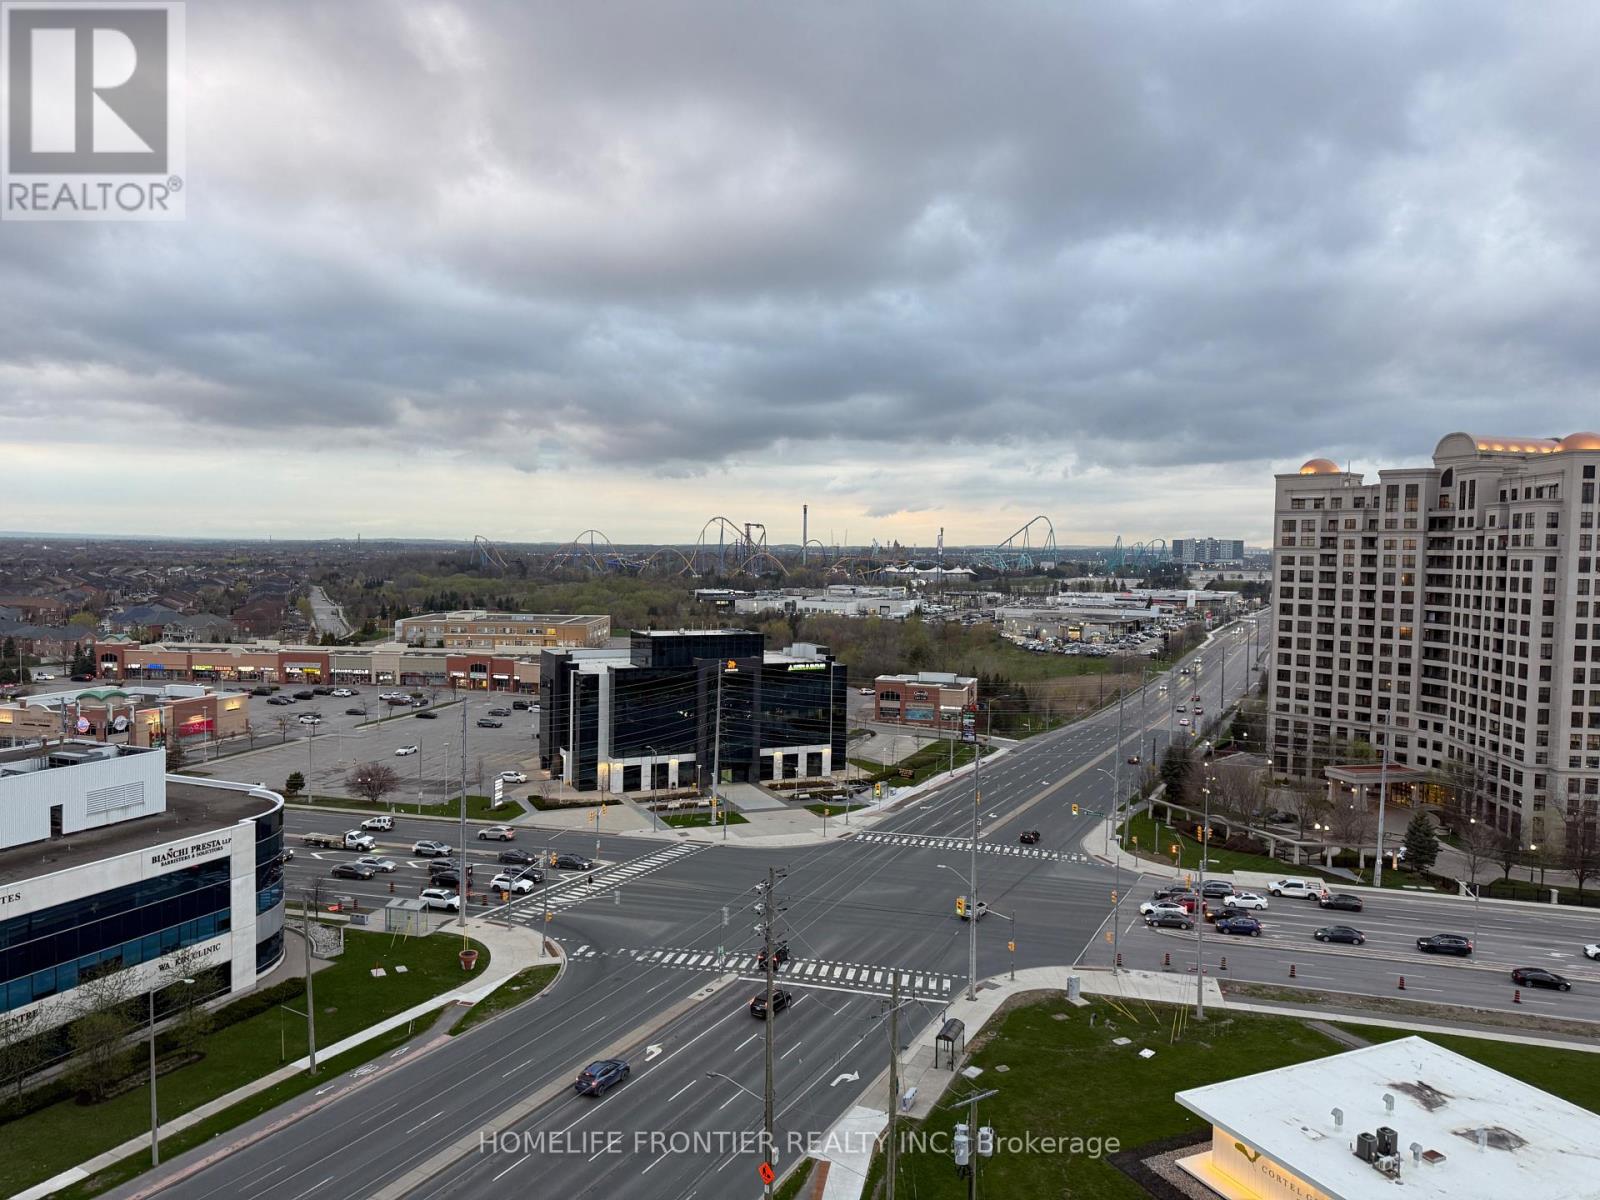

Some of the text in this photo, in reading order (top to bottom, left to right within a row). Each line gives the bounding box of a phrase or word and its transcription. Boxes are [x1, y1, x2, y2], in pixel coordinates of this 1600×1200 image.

[151, 847, 189, 864] BIANCHI
[191, 839, 221, 853] PRESTA
[161, 855, 191, 867] BARRISTERS
[196, 846, 224, 857] SOLICITORS
[193, 943, 221, 958] CLINIC
[1261, 1165, 1302, 1196] CORTEL
